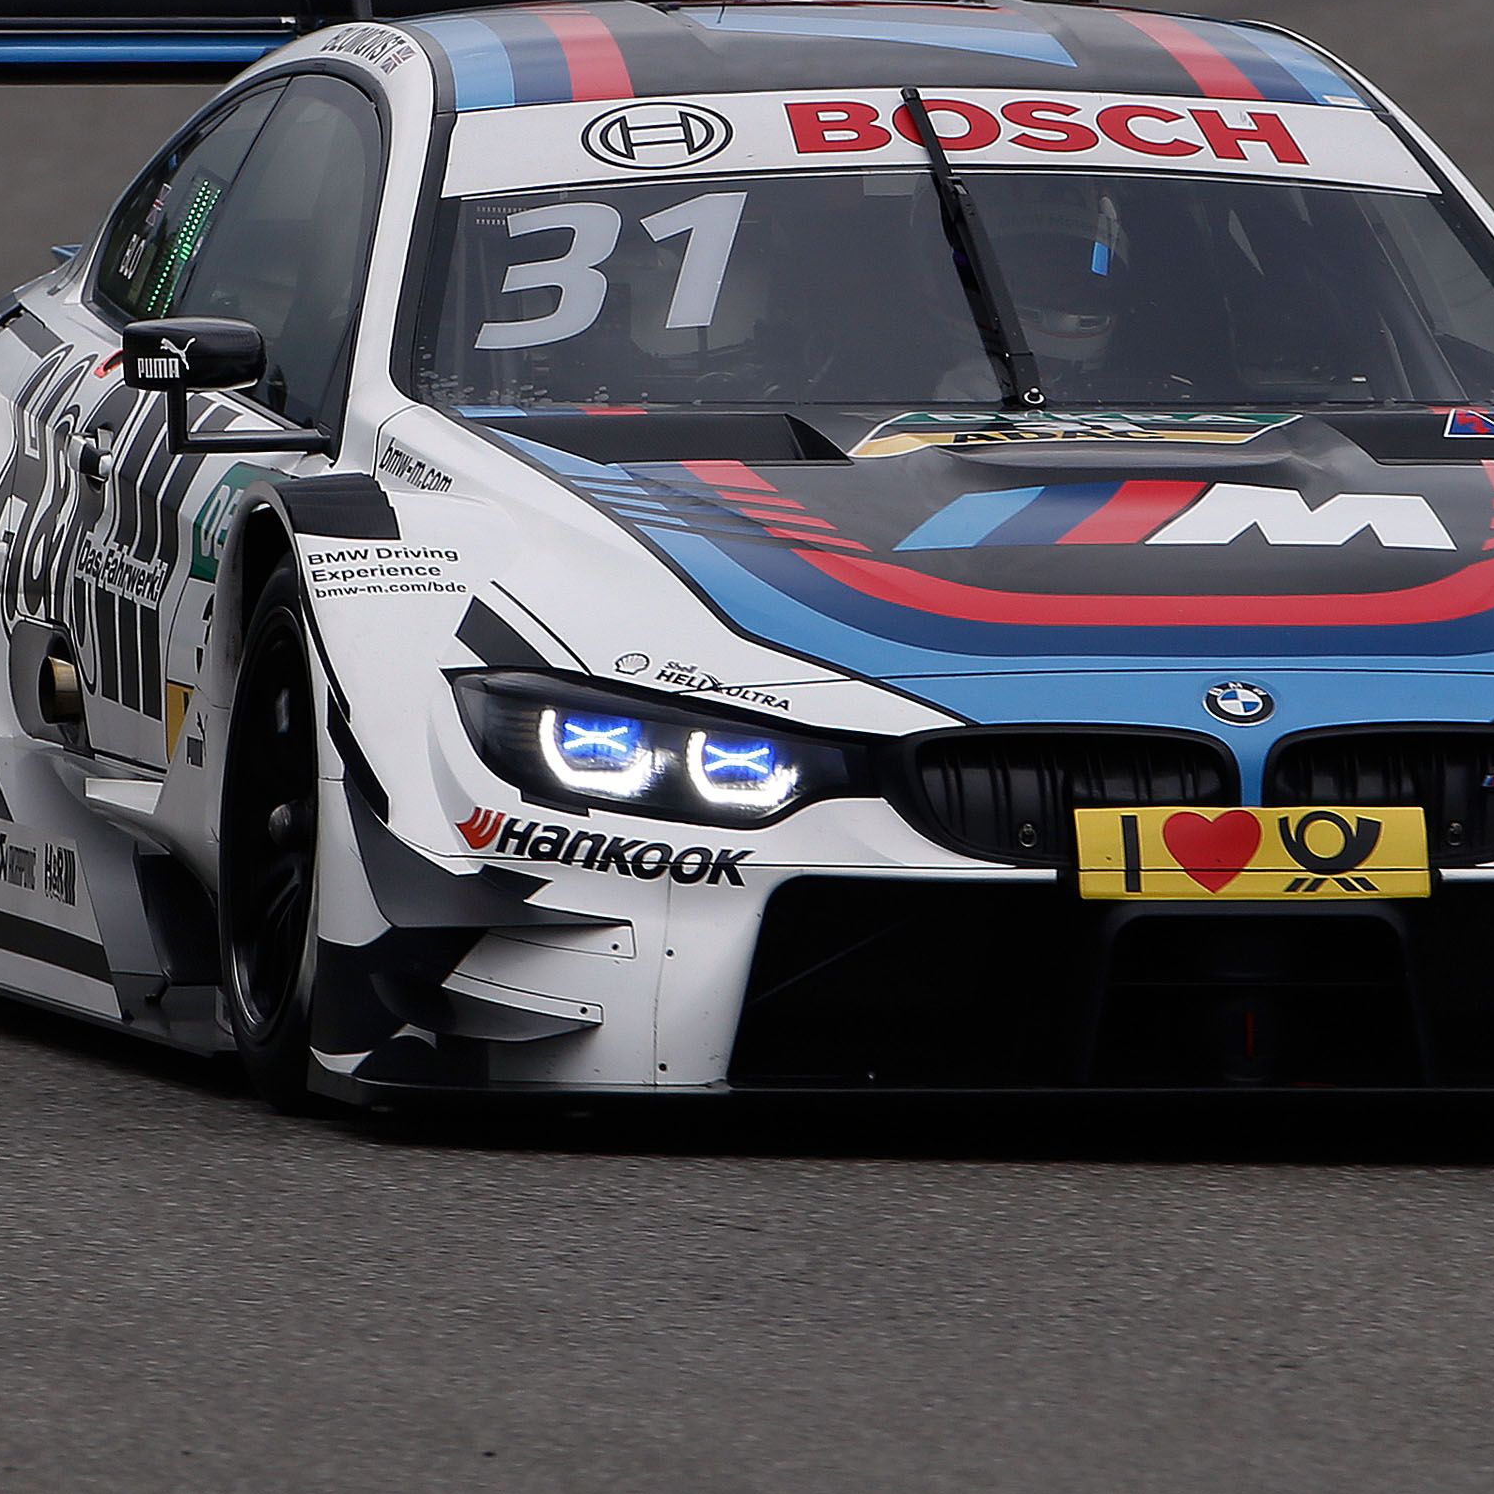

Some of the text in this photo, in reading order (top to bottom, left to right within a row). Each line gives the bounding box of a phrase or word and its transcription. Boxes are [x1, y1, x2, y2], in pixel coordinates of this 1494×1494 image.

[783, 96, 1310, 166] BOSCH
[473, 190, 749, 351] 31
[136, 357, 181, 379] PUMA
[952, 431, 1166, 443] ADAC
[378, 436, 454, 493] bmw-m.com
[1146, 482, 1458, 550] M
[77, 539, 103, 578] Das
[307, 547, 459, 566] BMW Driving
[311, 564, 442, 583] Experience
[721, 686, 791, 711] ULTRA
[1121, 815, 1143, 893] I
